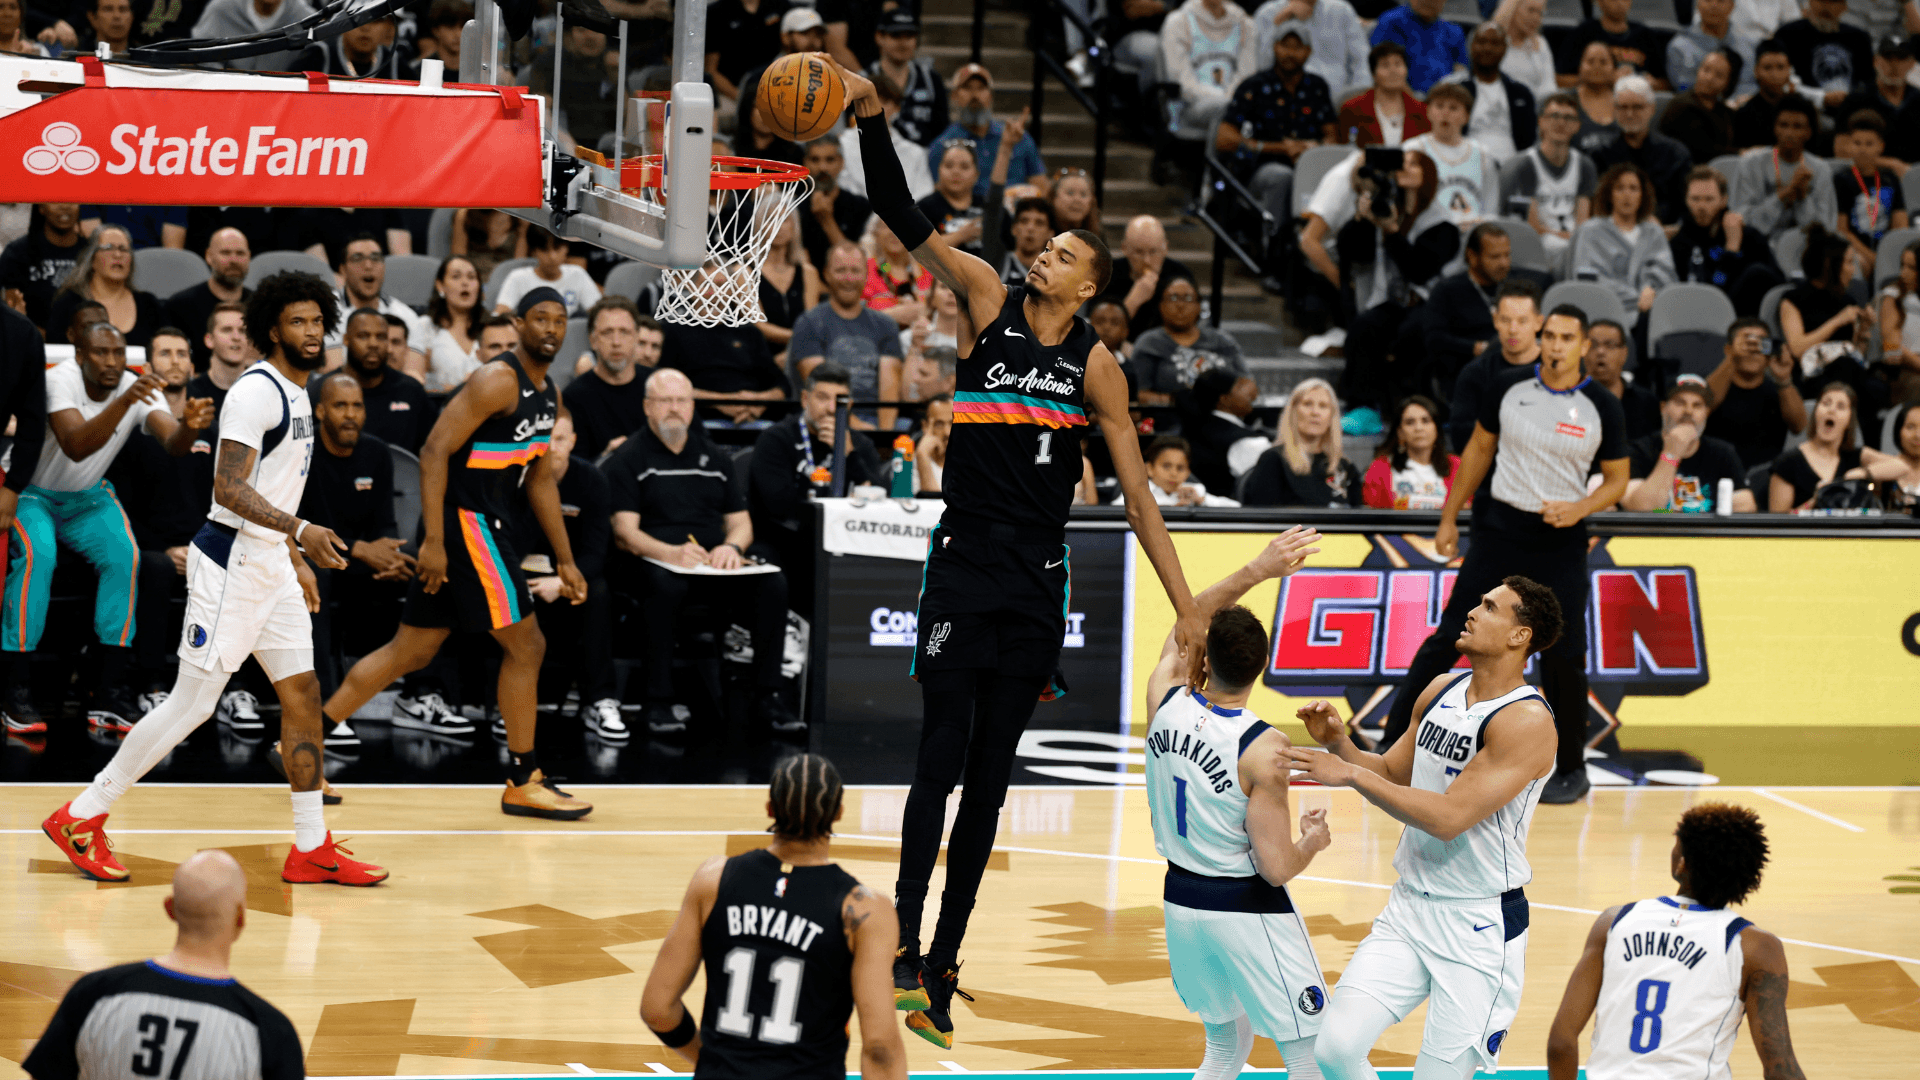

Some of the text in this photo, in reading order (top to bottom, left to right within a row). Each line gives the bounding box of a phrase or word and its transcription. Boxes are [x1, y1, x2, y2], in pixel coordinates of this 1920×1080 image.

[801, 60, 823, 114] Wilson
[106, 123, 368, 176] State Farm
[985, 362, 1077, 395] San Antonio
[1059, 360, 1080, 374] LEDGER
[1035, 432, 1052, 464] 1
[1270, 569, 1700, 675] GUN
[1148, 729, 1233, 794] POULAKIDAS
[1417, 719, 1473, 763] DALLAS
[1173, 775, 1188, 839] 1
[726, 904, 824, 952] BRYANT
[1623, 931, 1707, 970] JOHNSON
[715, 946, 805, 1044] 11
[1629, 979, 1671, 1054] 8
[131, 1013, 200, 1080] 37
